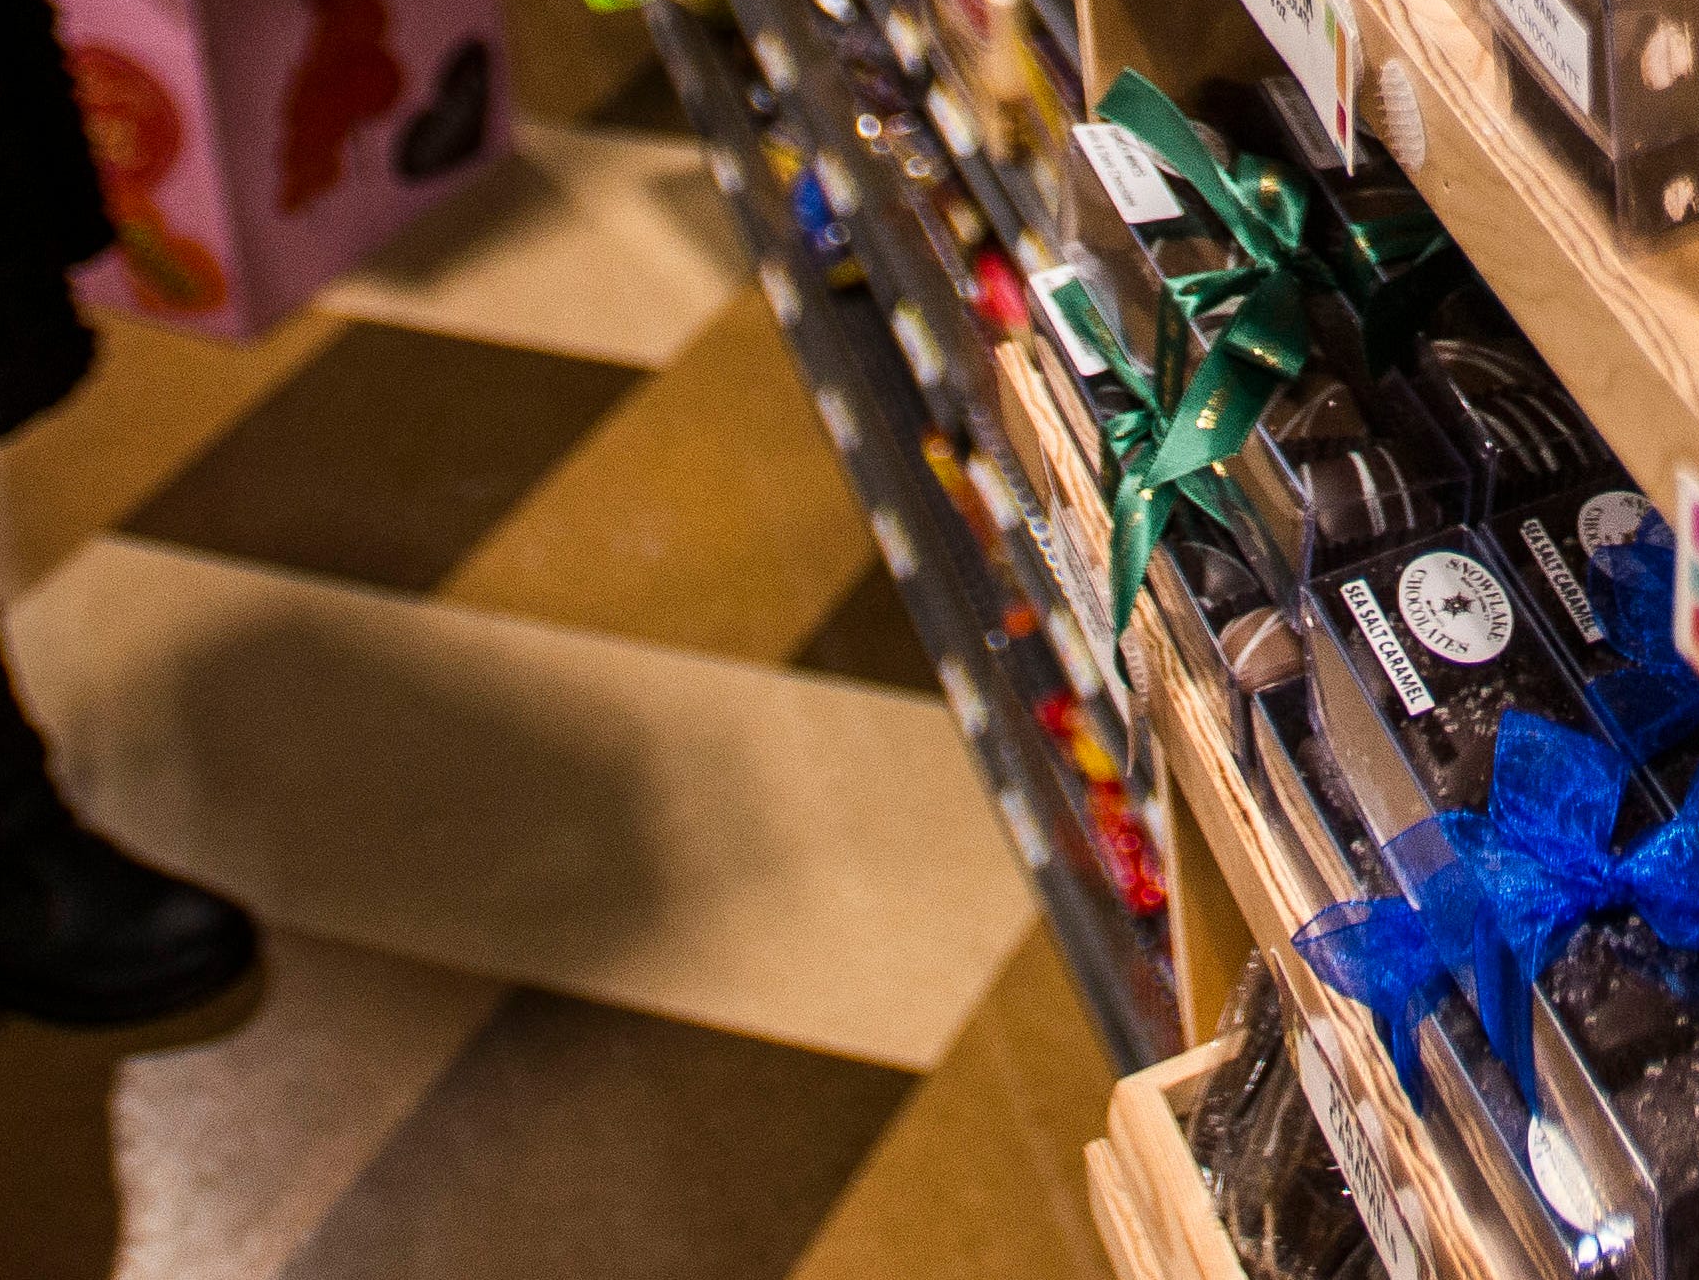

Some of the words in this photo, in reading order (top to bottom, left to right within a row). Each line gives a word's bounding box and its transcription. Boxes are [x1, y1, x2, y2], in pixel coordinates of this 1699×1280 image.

[1517, 4, 1581, 90] CHOCOLATE
[1403, 568, 1469, 656] CHOCOLATES
[1444, 557, 1510, 643] SNOWFLAKE
[1345, 584, 1367, 611] SEA
[1359, 609, 1388, 644] SALT
[1378, 638, 1427, 705] CARAMEL
